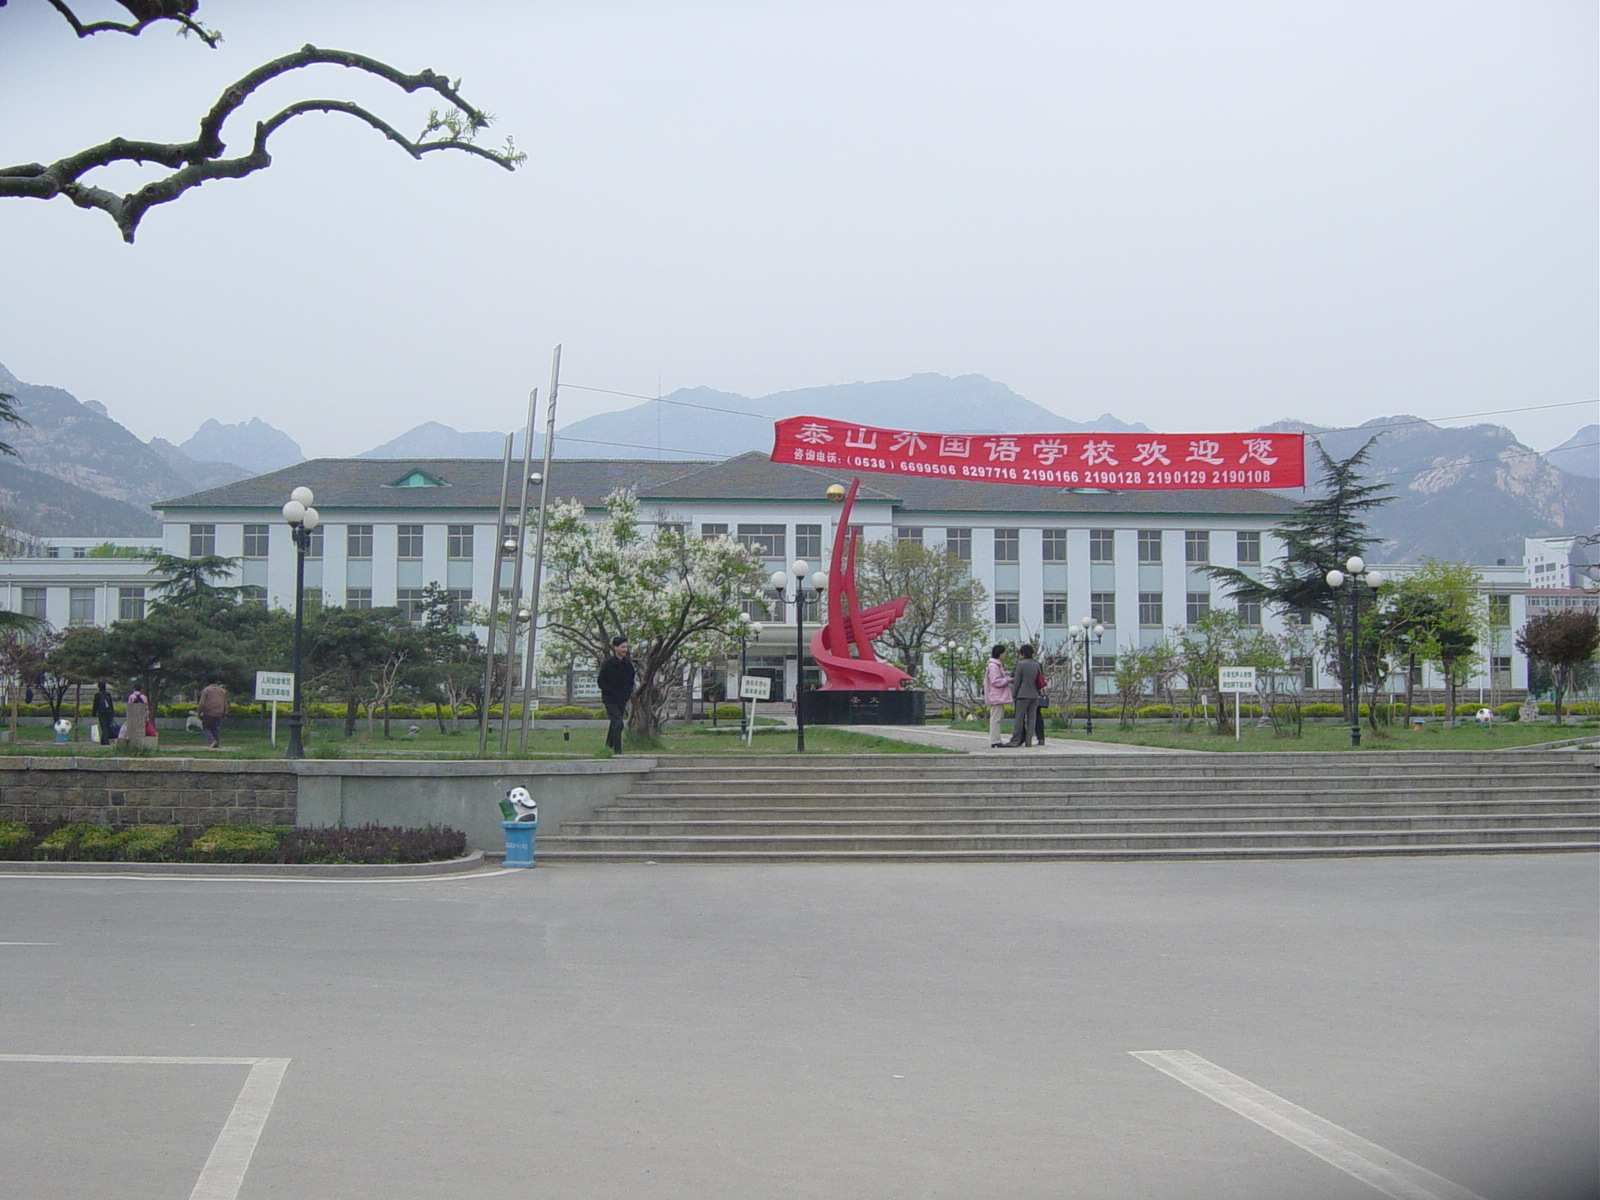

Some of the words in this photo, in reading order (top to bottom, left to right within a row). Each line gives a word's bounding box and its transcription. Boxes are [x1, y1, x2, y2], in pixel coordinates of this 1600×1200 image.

[795, 423, 1278, 466] 泰山外国语学校欢迎您
[900, 461, 957, 475] 6699506
[962, 465, 1017, 480] 8297716
[1022, 469, 1079, 483] 2190166
[1084, 471, 1142, 484] 2190128
[1147, 471, 1206, 485] 2190129
[1212, 471, 1270, 484] 2190108
